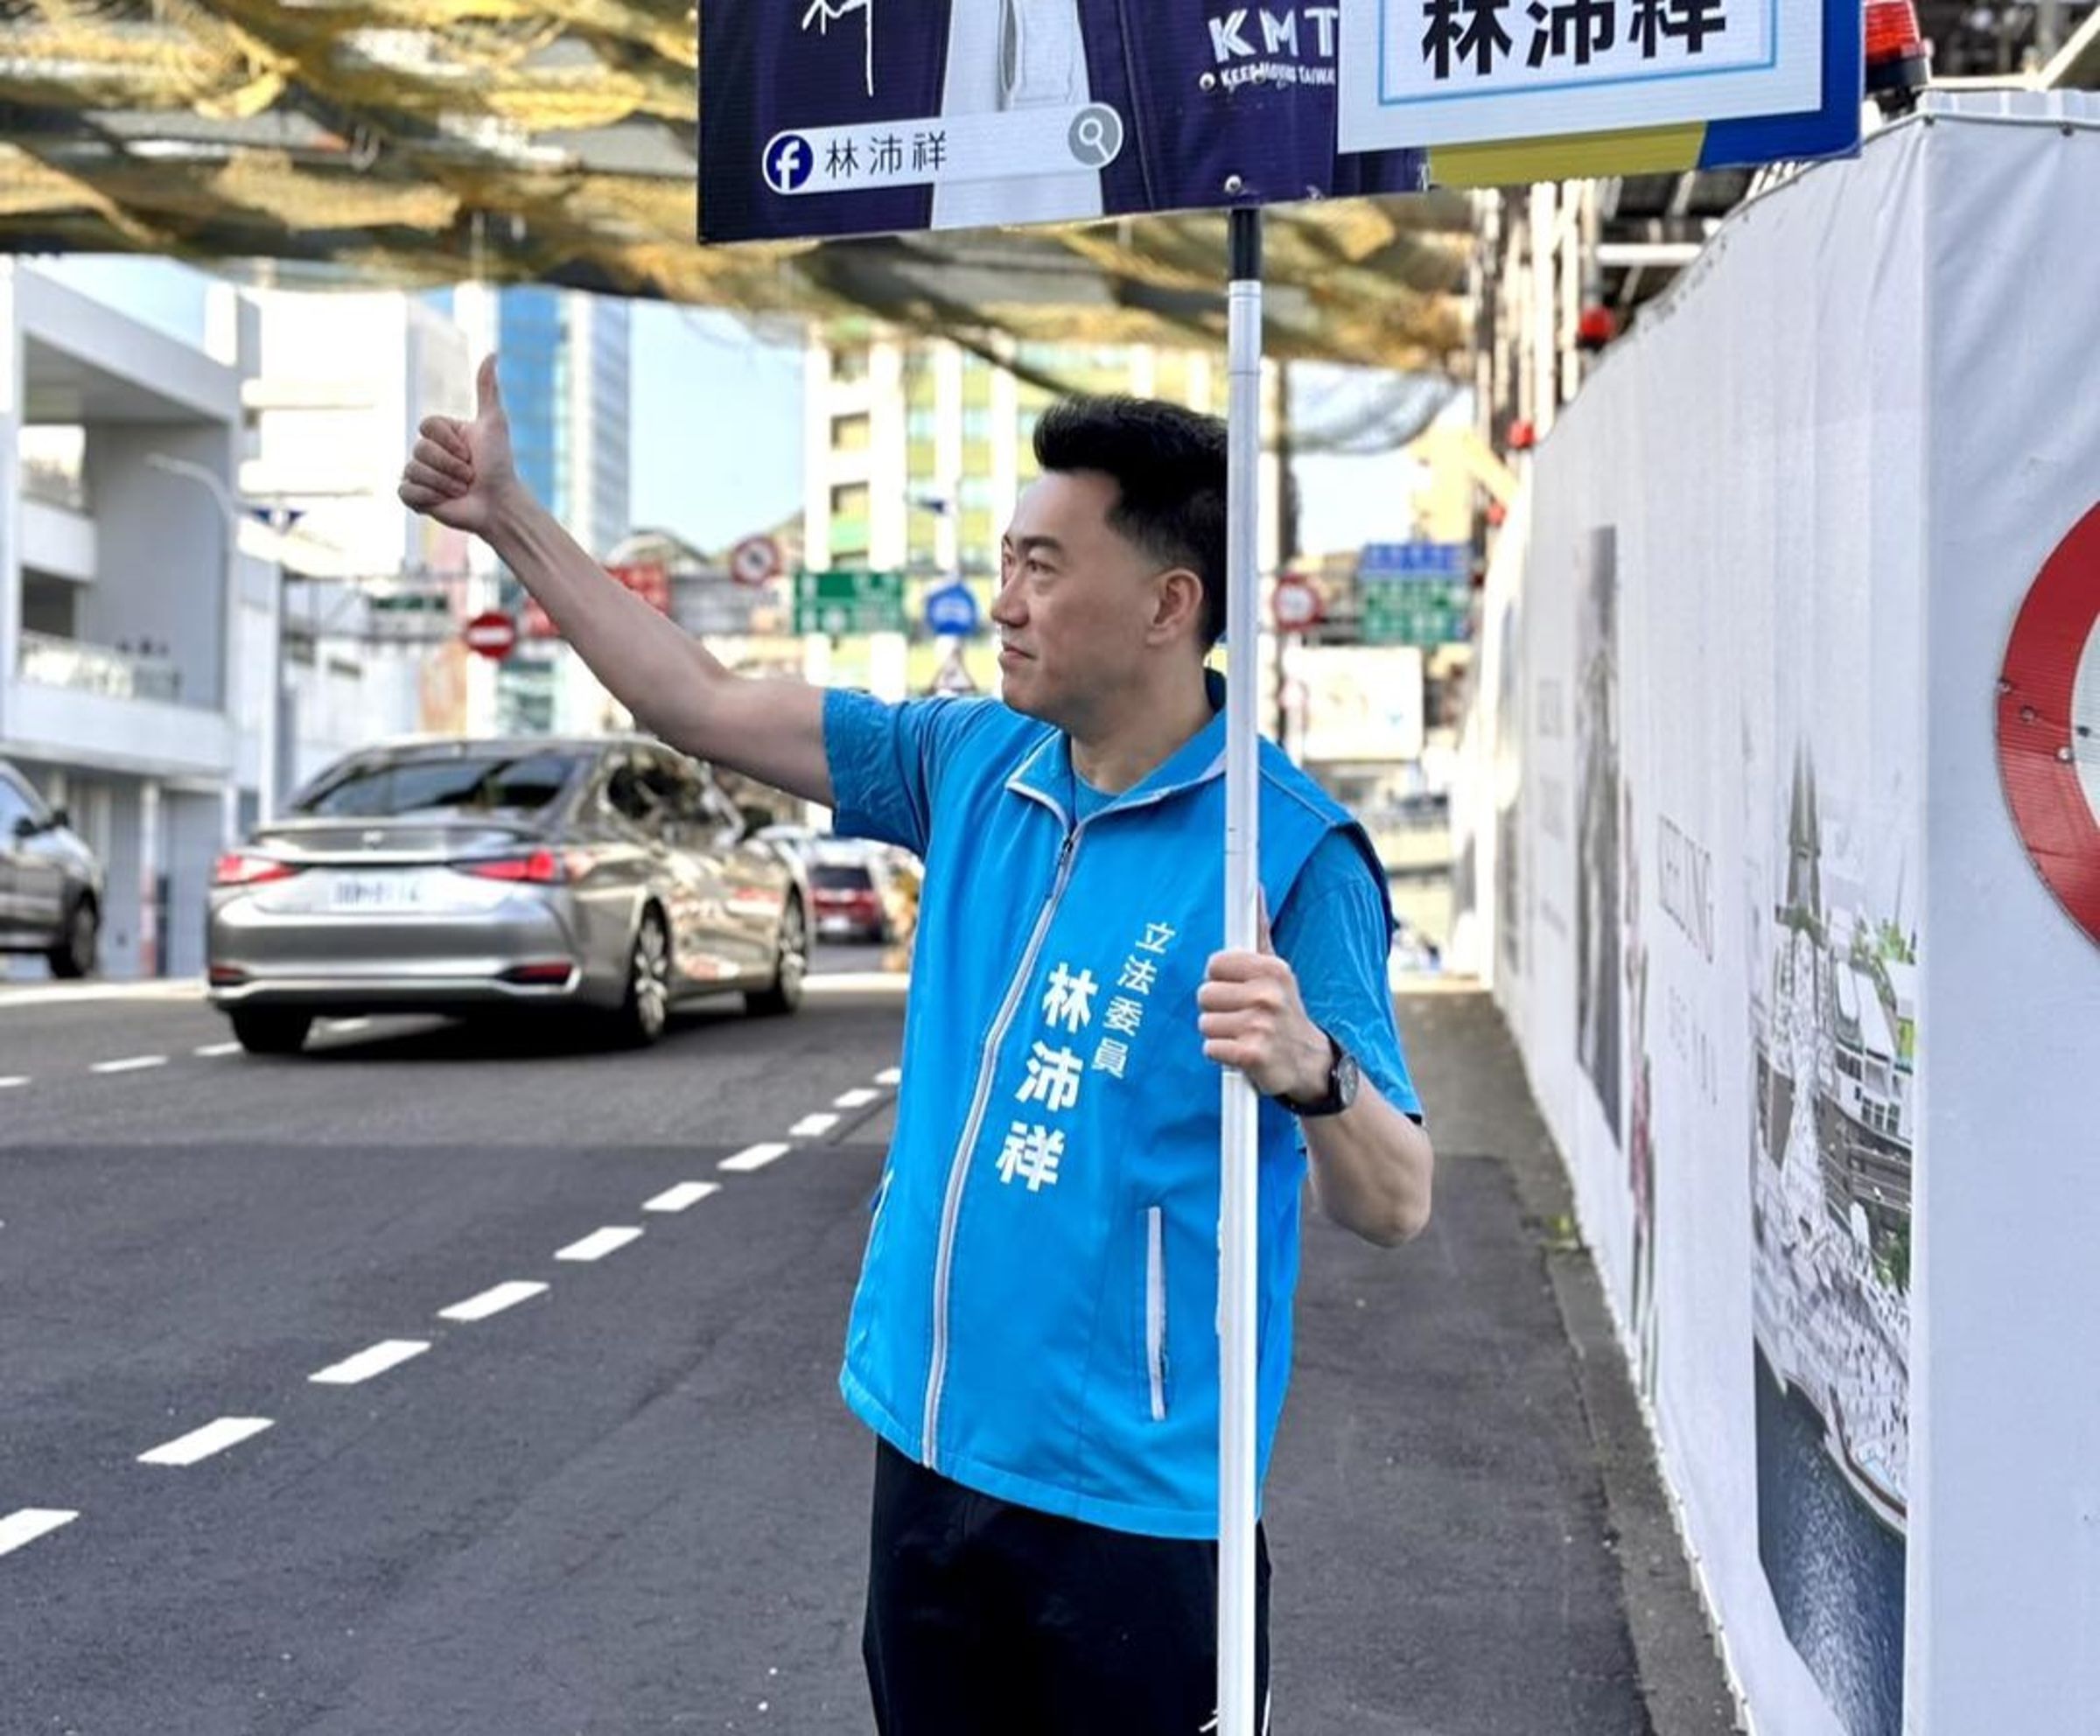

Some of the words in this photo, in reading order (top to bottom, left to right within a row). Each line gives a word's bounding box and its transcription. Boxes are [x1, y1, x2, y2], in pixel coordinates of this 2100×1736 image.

[1208, 8, 1338, 63] KMT
[1298, 65, 1336, 85] TAIWA
[825, 131, 948, 178] 林沛祥
[1091, 921, 1176, 1079] 立法委員
[995, 962, 1098, 1192] 林沛祥
